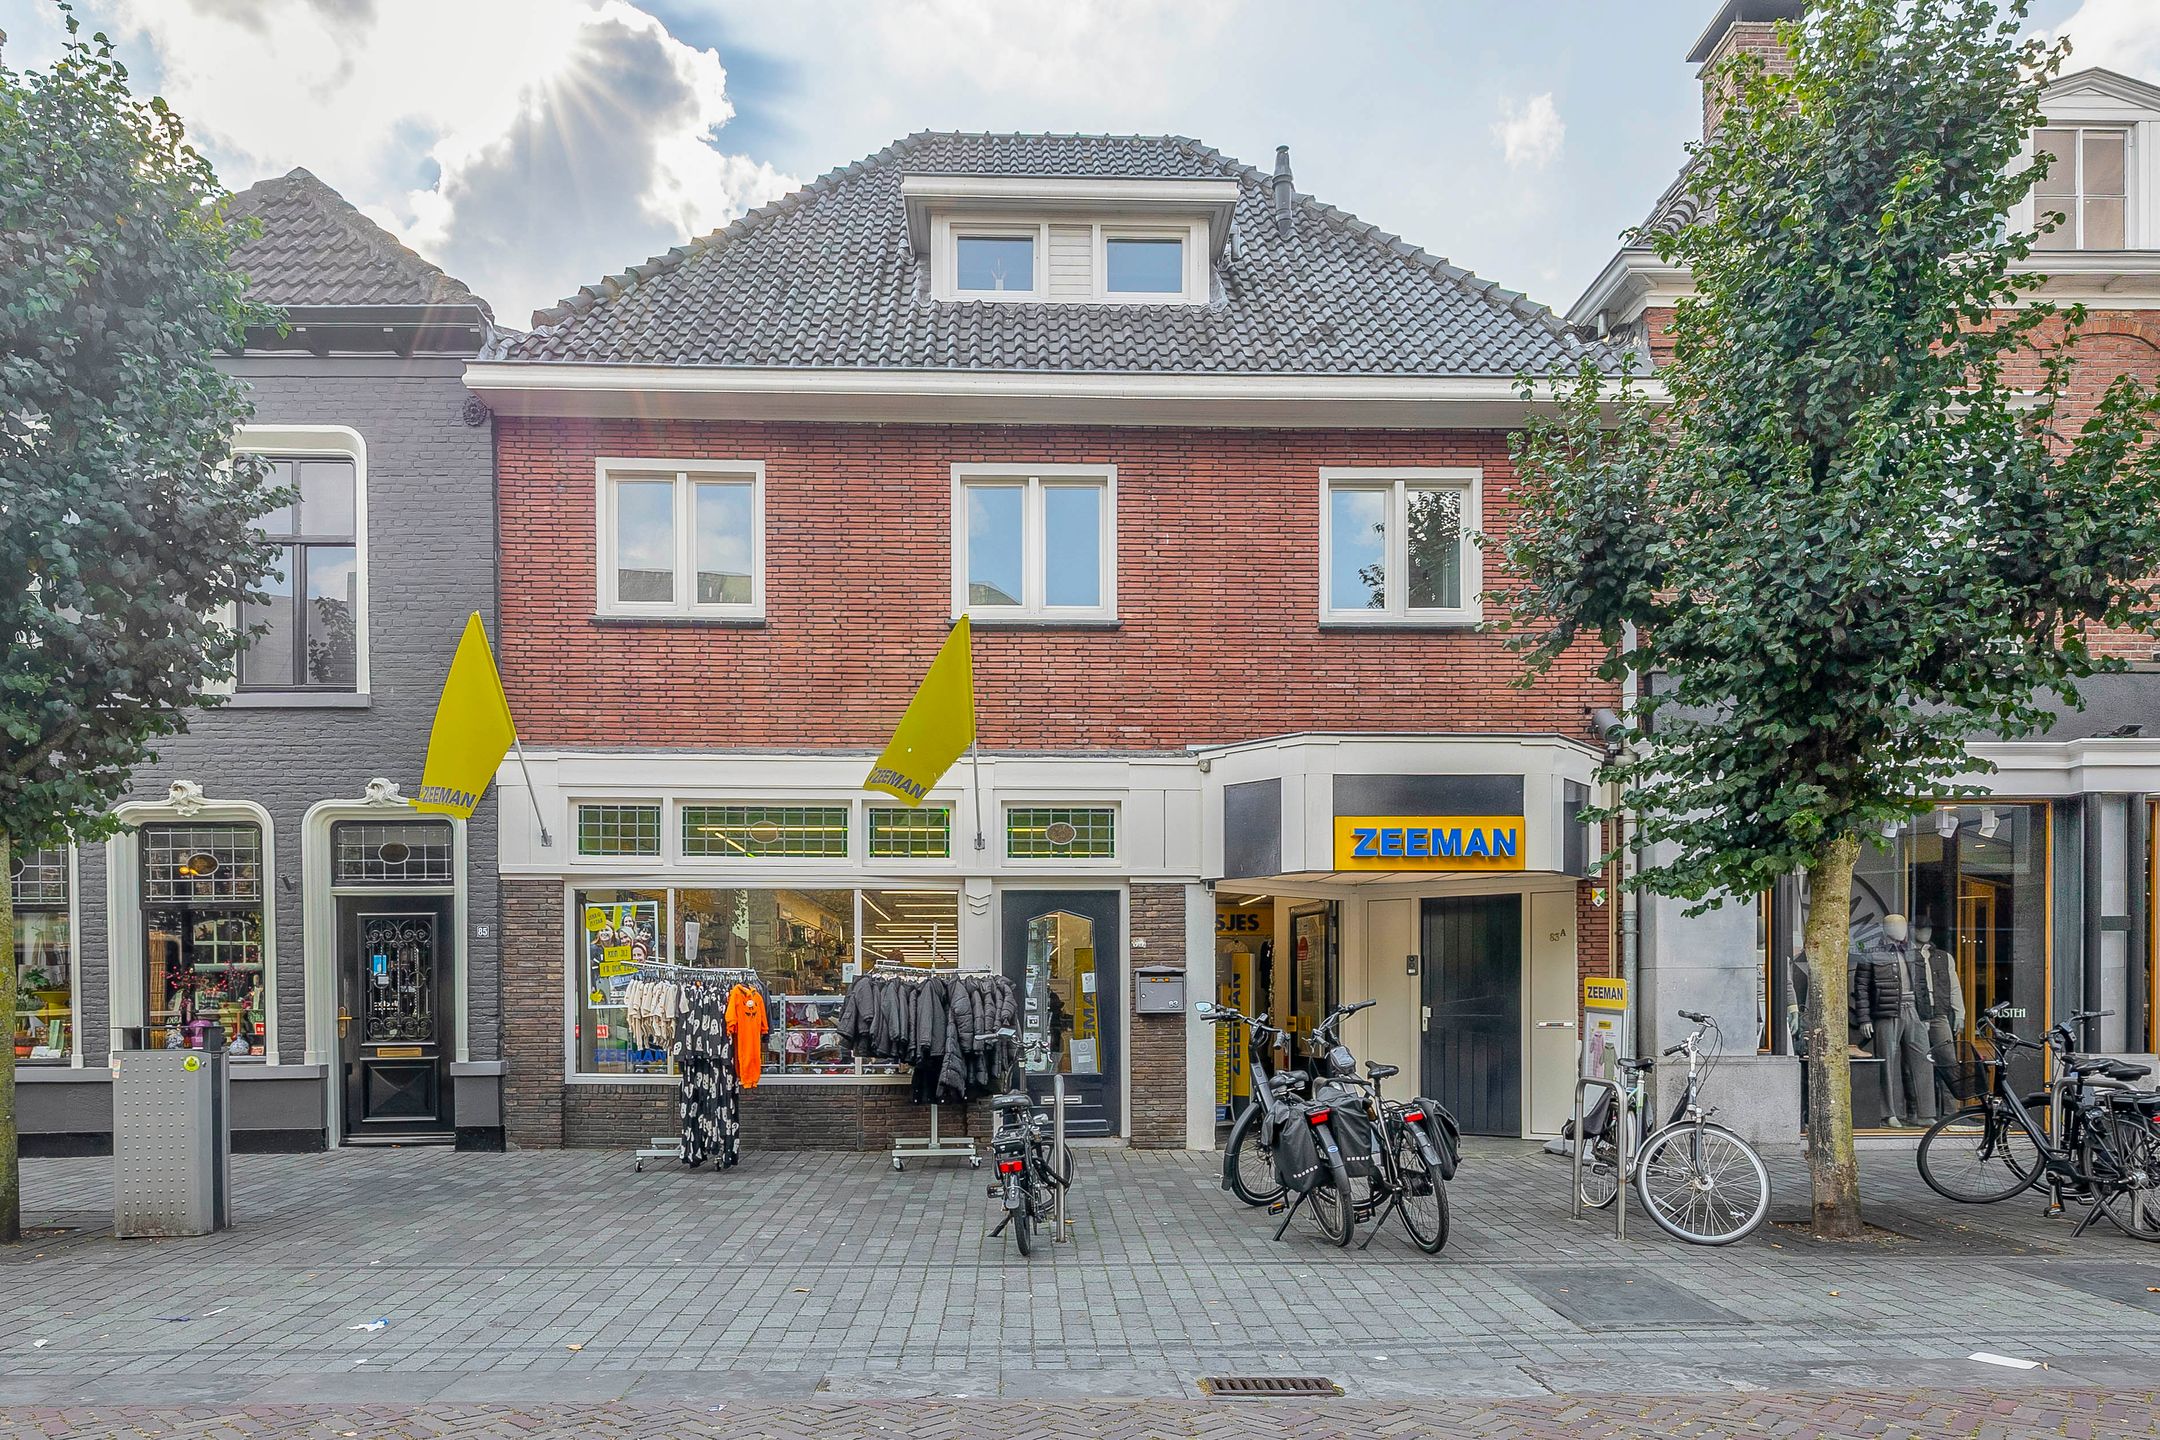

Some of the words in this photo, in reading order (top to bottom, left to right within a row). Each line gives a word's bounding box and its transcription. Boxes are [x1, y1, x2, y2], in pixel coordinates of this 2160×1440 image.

[1353, 828, 1516, 857] ZEEMAN
[478, 927, 488, 936] 85
[1587, 986, 1623, 1001] ZEEMAN
[593, 1049, 667, 1062] ZEEMAN
